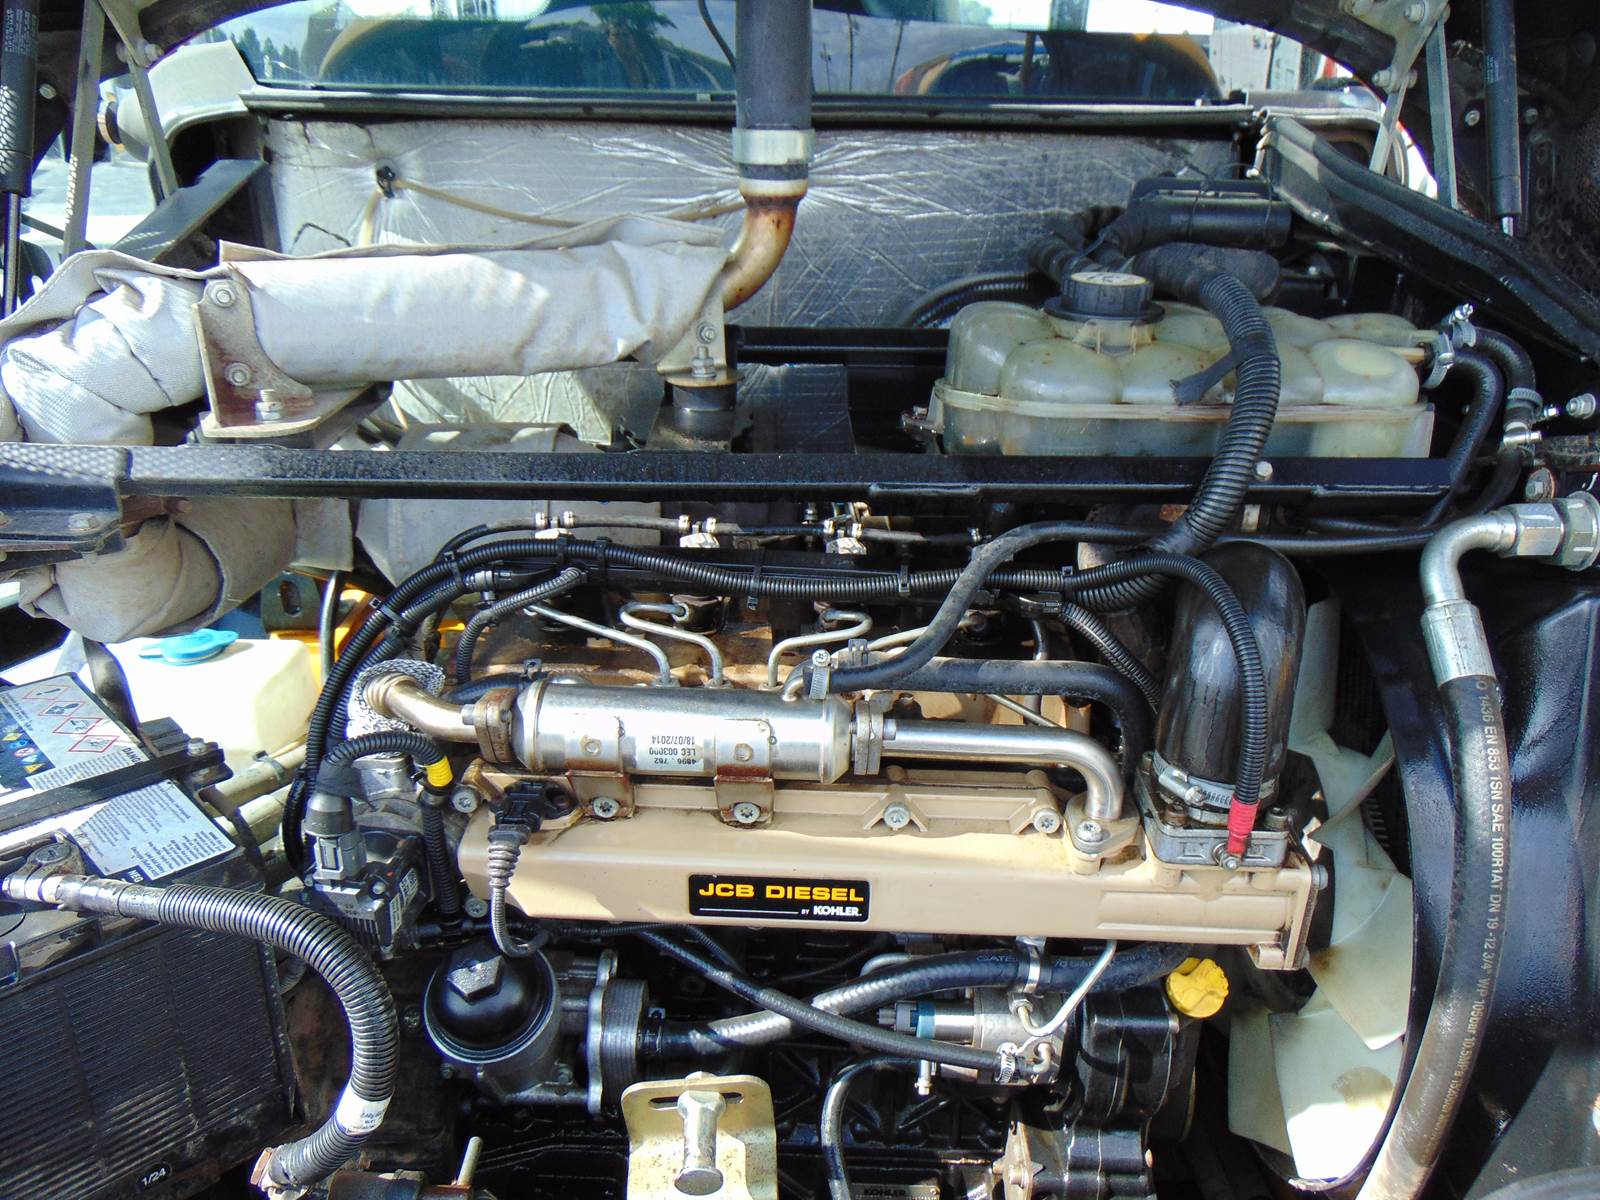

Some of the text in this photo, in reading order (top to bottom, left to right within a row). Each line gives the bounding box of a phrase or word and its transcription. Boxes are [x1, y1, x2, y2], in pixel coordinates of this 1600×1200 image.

[1479, 694, 1495, 722] 1436
[651, 735, 695, 745] 18/07/2014
[1485, 726, 1498, 745] EN
[680, 747, 696, 756] LEC
[1487, 747, 1500, 771] 853
[1490, 775, 1503, 800] 1SN
[1491, 803, 1505, 832] SAE
[1491, 837, 1505, 891] 100R1AT
[699, 882, 864, 902] JCB DIESEL
[813, 905, 860, 917] KOHLER
[1488, 894, 1502, 913] DN
[1486, 916, 1500, 929] 19
[1476, 978, 1491, 997] WP
[1467, 1000, 1486, 1034] 105bar
[141, 1167, 166, 1186] 1/24
